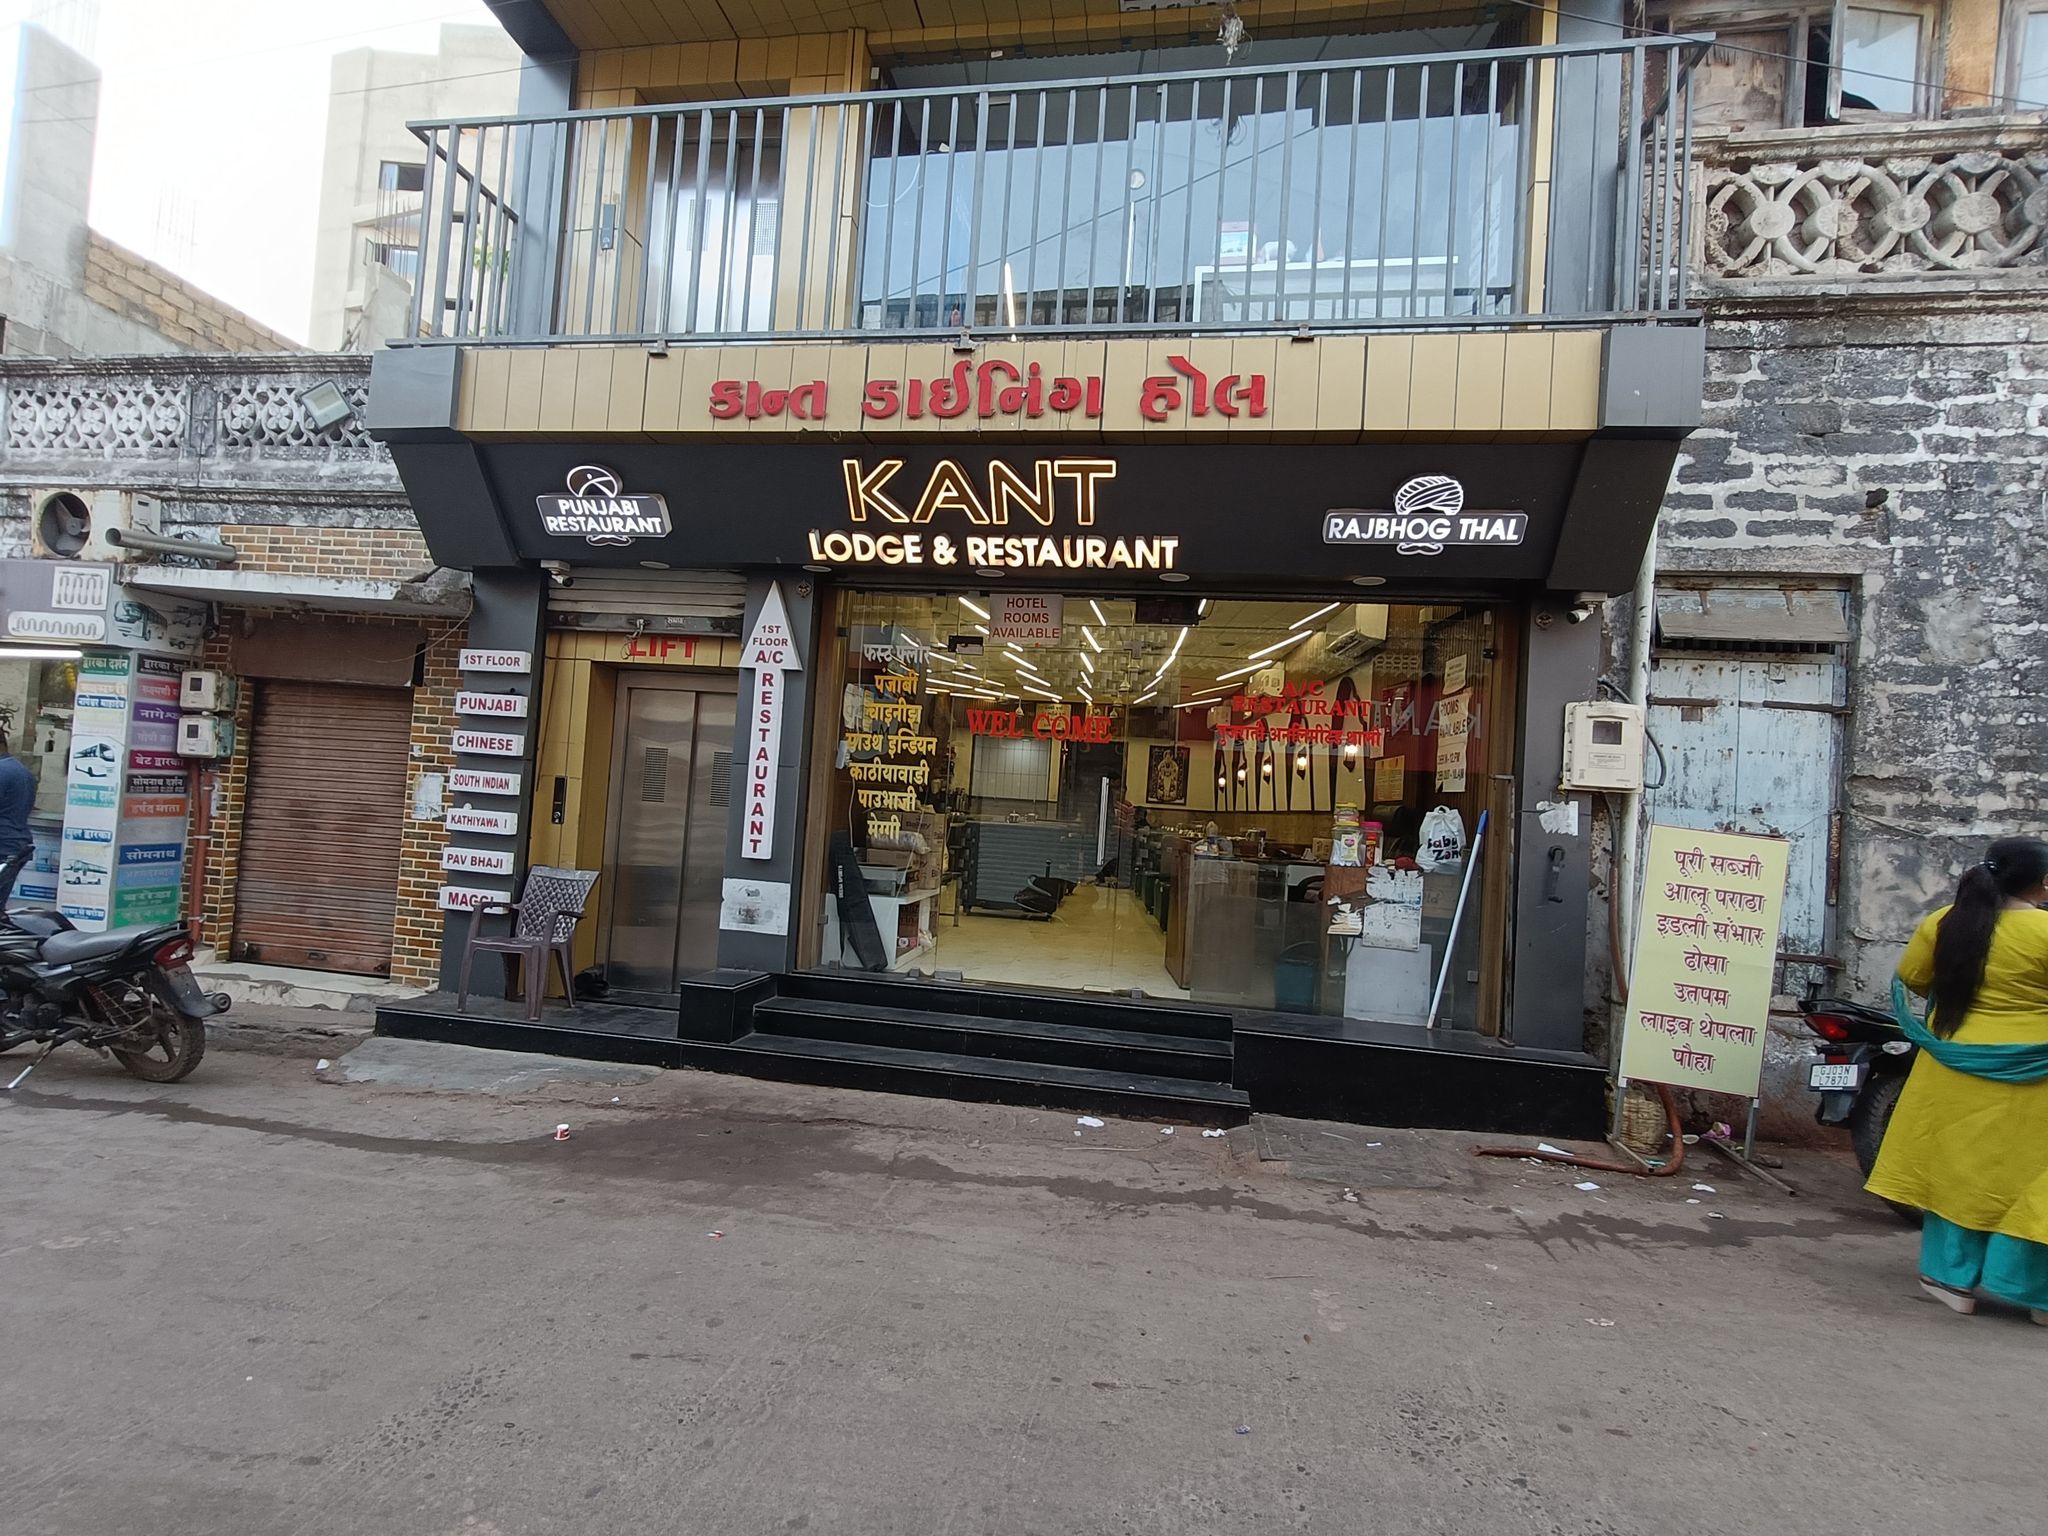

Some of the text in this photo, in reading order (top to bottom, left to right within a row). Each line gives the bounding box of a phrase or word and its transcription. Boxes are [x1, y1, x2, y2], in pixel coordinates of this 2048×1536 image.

[1139, 355, 1268, 422] હોલ
[842, 457, 1117, 526] KANT
[557, 498, 641, 517] PUNJABI
[545, 516, 662, 534] RESTAURANT
[1327, 517, 1519, 541] RAJBHOG THAL
[808, 529, 1180, 569] LODGE & RESTAURANT
[1006, 597, 1048, 609] HOTEL
[1003, 612, 1050, 624] ROOMS
[761, 624, 782, 634] 1ST
[991, 627, 1061, 639] AVAILABLE
[629, 634, 700, 658] LIFT
[752, 637, 788, 647] FLOOR
[463, 654, 521, 667] 1ST FLOOR
[754, 649, 784, 664] A/C
[459, 697, 517, 712] PUNJABI
[1232, 694, 1372, 717] RESTAURANT
[966, 707, 1025, 739] WEL
[1032, 713, 1113, 744] COME
[457, 734, 514, 752] CHINESE
[749, 672, 774, 855] RESTAURANT
[453, 773, 511, 790] SOUTH INDIAN
[450, 814, 499, 829] KATHIYAWA
[446, 853, 504, 869] PAV BHAJI
[1673, 846, 1763, 880] पूरी सब्जी
[1664, 882, 1766, 914] आलू पराठा
[1655, 913, 1765, 948] इडली संभार
[1683, 944, 1729, 975] ढोसा
[1673, 982, 1730, 1008] उतपम
[1639, 1010, 1757, 1047] लाइव थेपला
[1820, 1065, 1851, 1076] GJ03N
[1819, 1076, 1849, 1086] L7870
